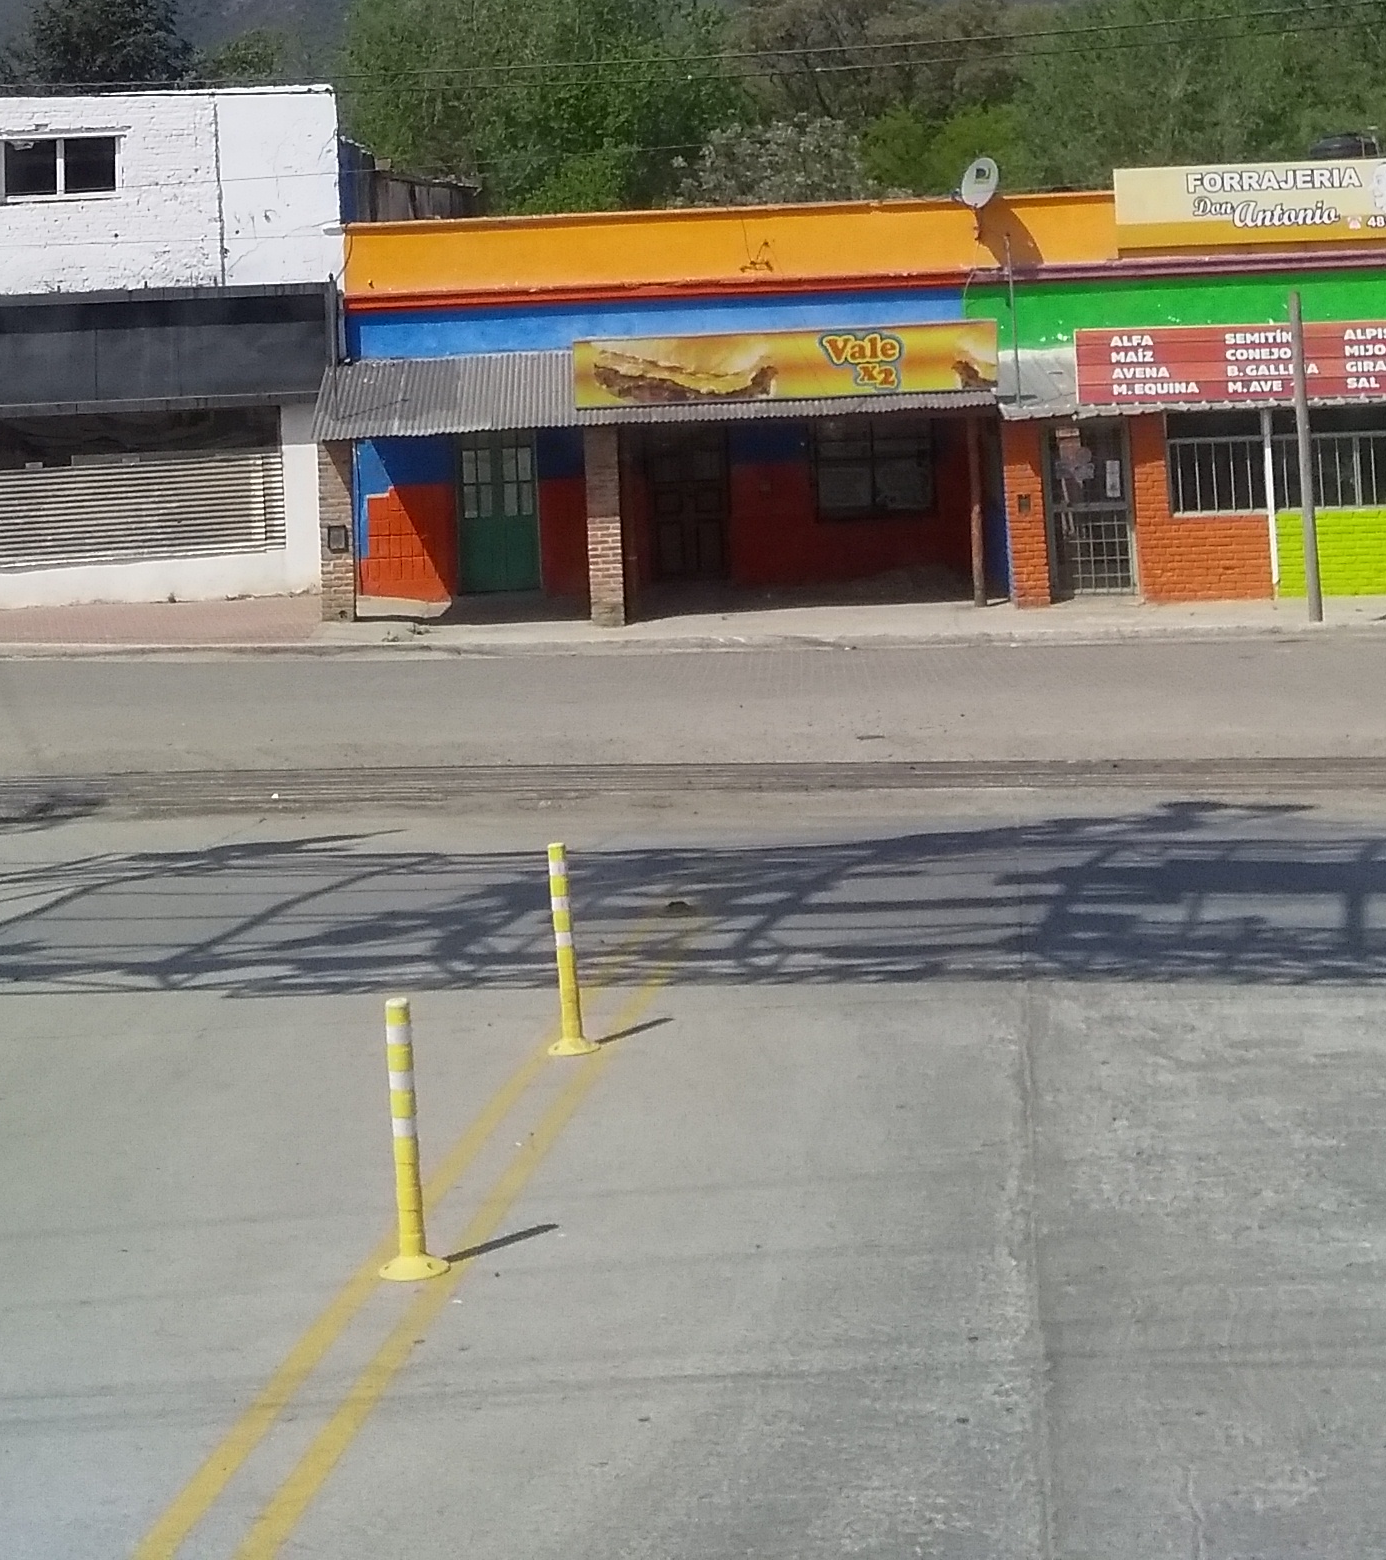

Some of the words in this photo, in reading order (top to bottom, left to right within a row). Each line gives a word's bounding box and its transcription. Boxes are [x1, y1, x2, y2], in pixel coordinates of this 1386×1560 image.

[1186, 167, 1362, 194] FORRAJERIA
[1193, 196, 1234, 217] Don
[1232, 200, 1341, 229] Antonio
[1110, 334, 1154, 347] ALFA
[1224, 329, 1292, 345] SEMITÍN
[823, 333, 899, 364] Vale
[1111, 348, 1154, 363] MAÍZ
[1225, 347, 1292, 361] CONEJO
[1344, 343, 1386, 357] MIJO
[1112, 366, 1170, 379] AVENA
[1346, 377, 1380, 389] SAL
